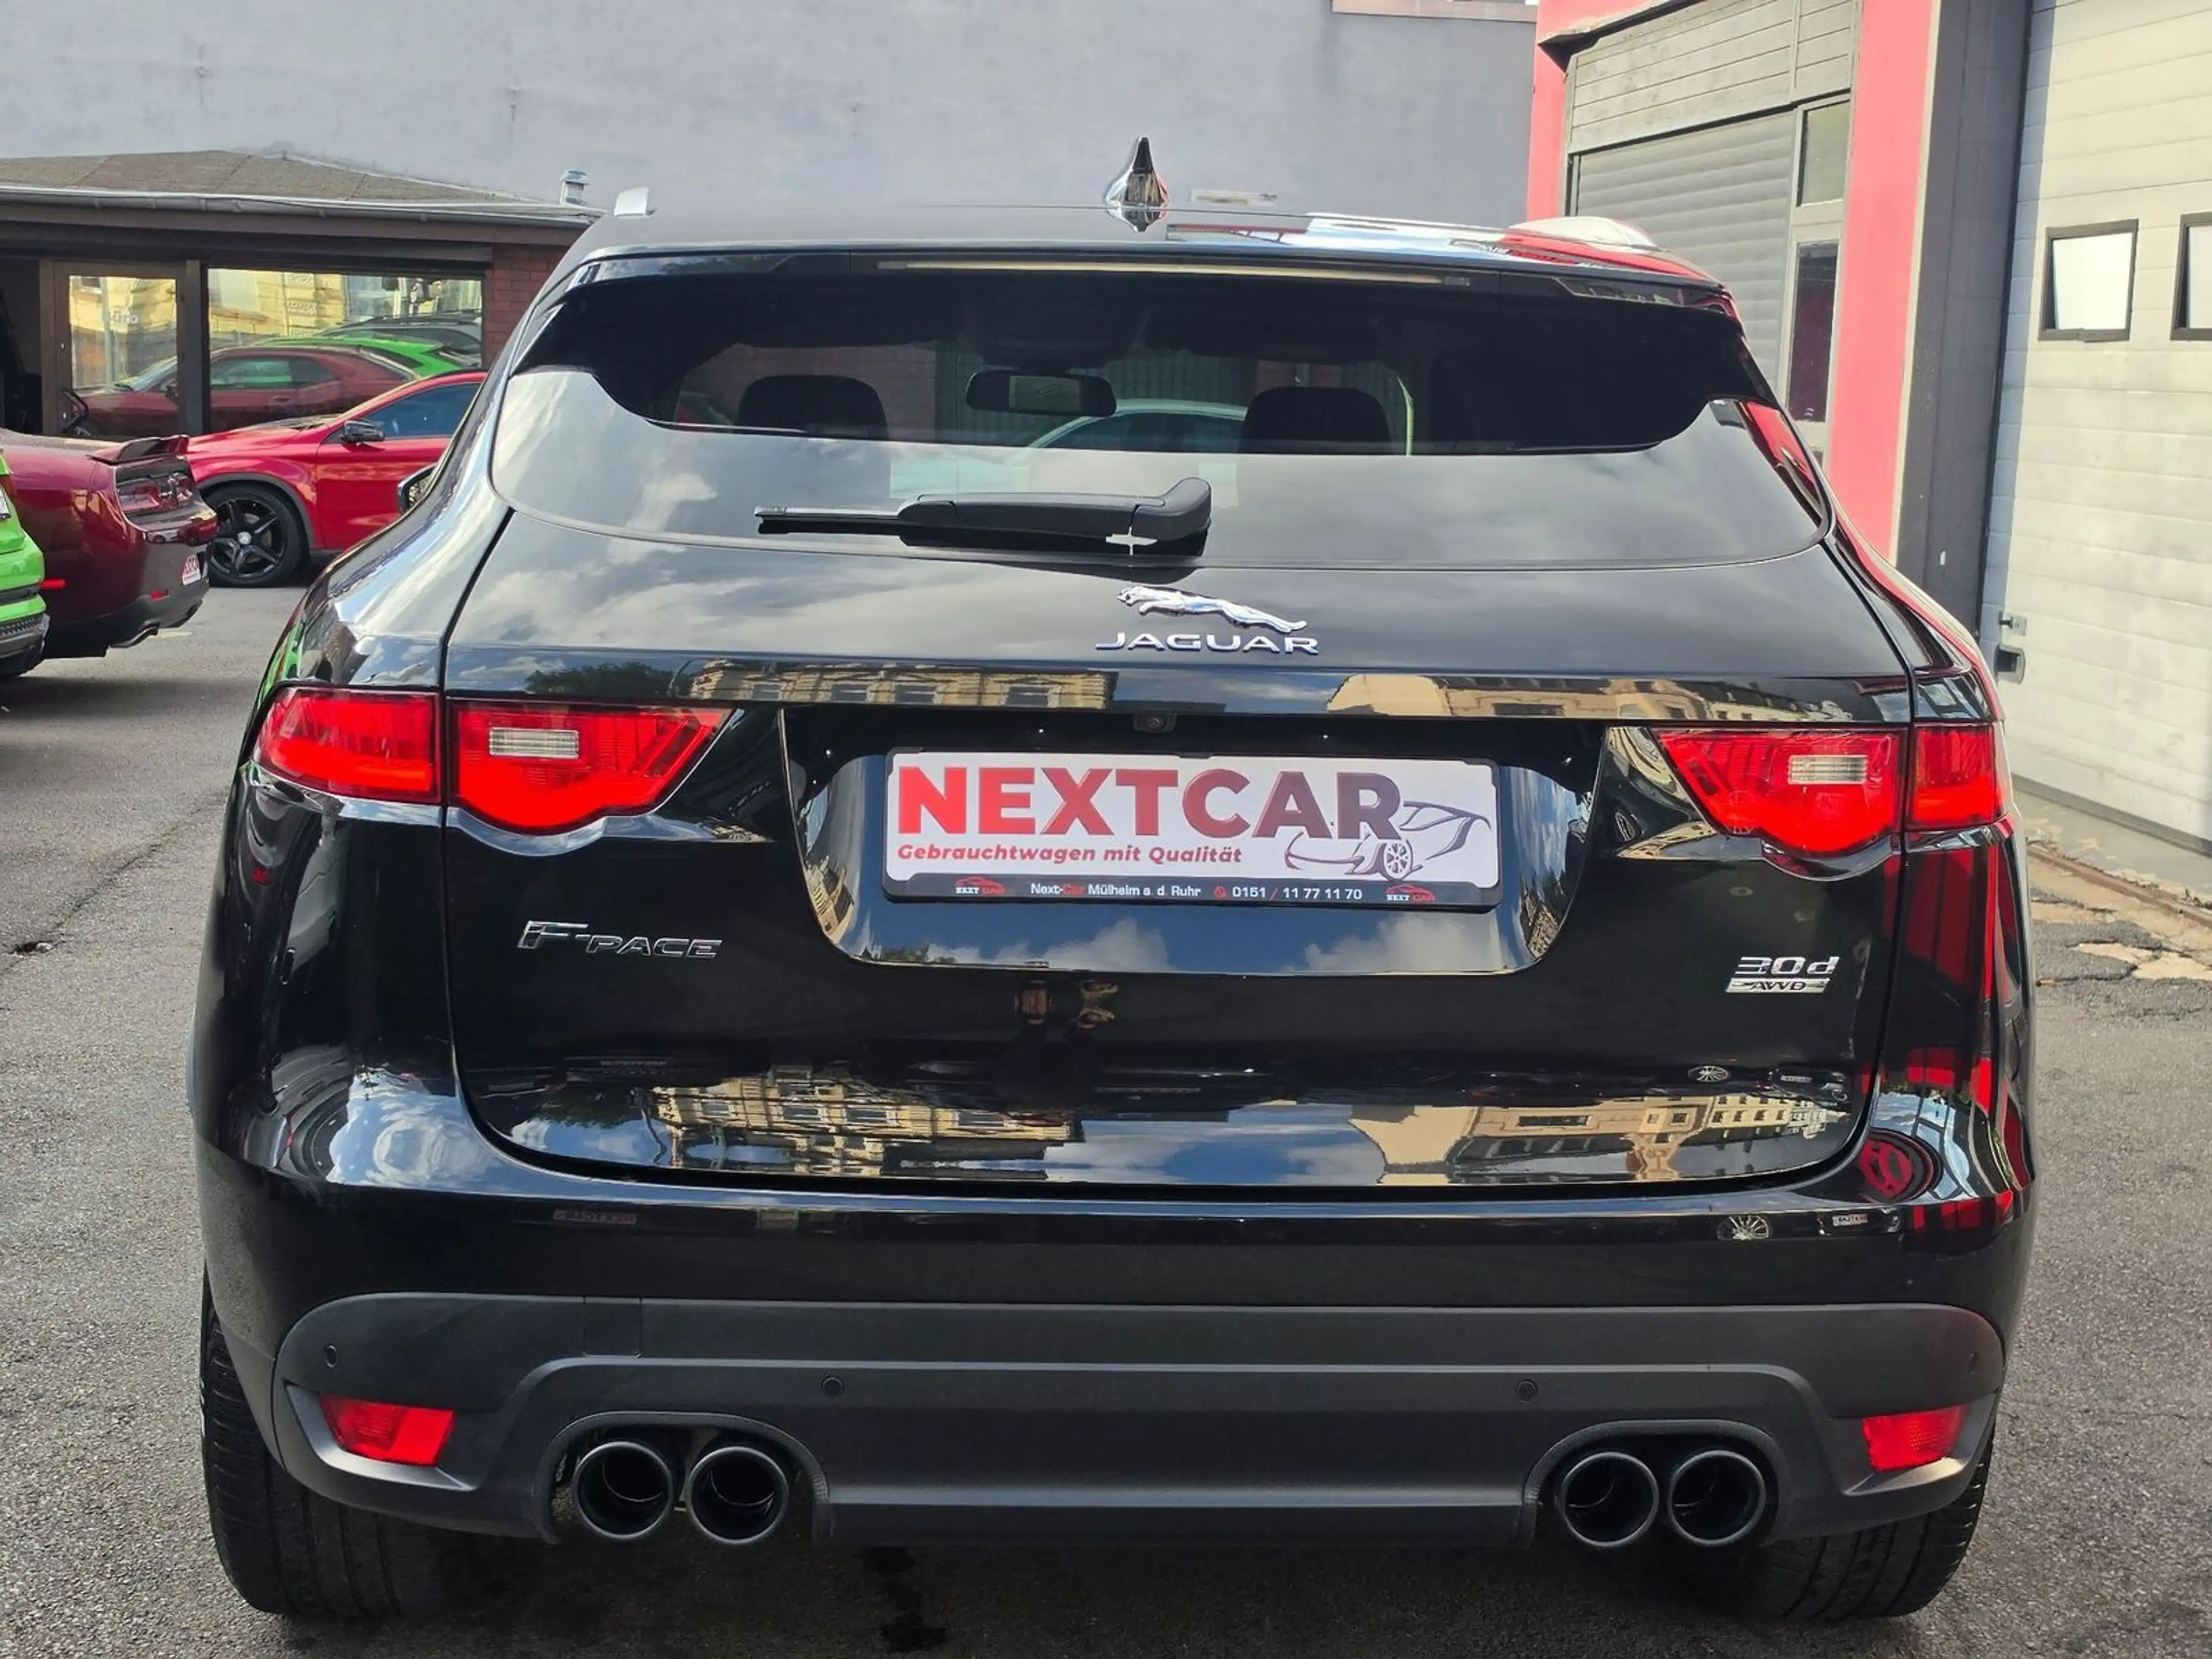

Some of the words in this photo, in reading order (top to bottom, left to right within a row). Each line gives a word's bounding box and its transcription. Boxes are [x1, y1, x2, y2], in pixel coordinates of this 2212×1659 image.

[1095, 632, 1319, 655] JAGUAR
[898, 766, 1402, 839] NEXTCAR
[897, 843, 1095, 864] Gebrauchtwagen
[1103, 845, 1141, 861] mit
[1149, 846, 1242, 864] Qualität
[1088, 884, 1140, 896] Mülheim
[1171, 885, 1202, 897] Ruhr
[1232, 887, 1266, 898] 0151
[1283, 888, 1298, 899] 11
[1303, 888, 1320, 899] 77
[1324, 888, 1340, 900] 11
[1344, 889, 1363, 900] 70
[517, 921, 723, 959] F-PACE
[1734, 956, 1840, 975] 30d
[1750, 981, 1807, 991] AWD
